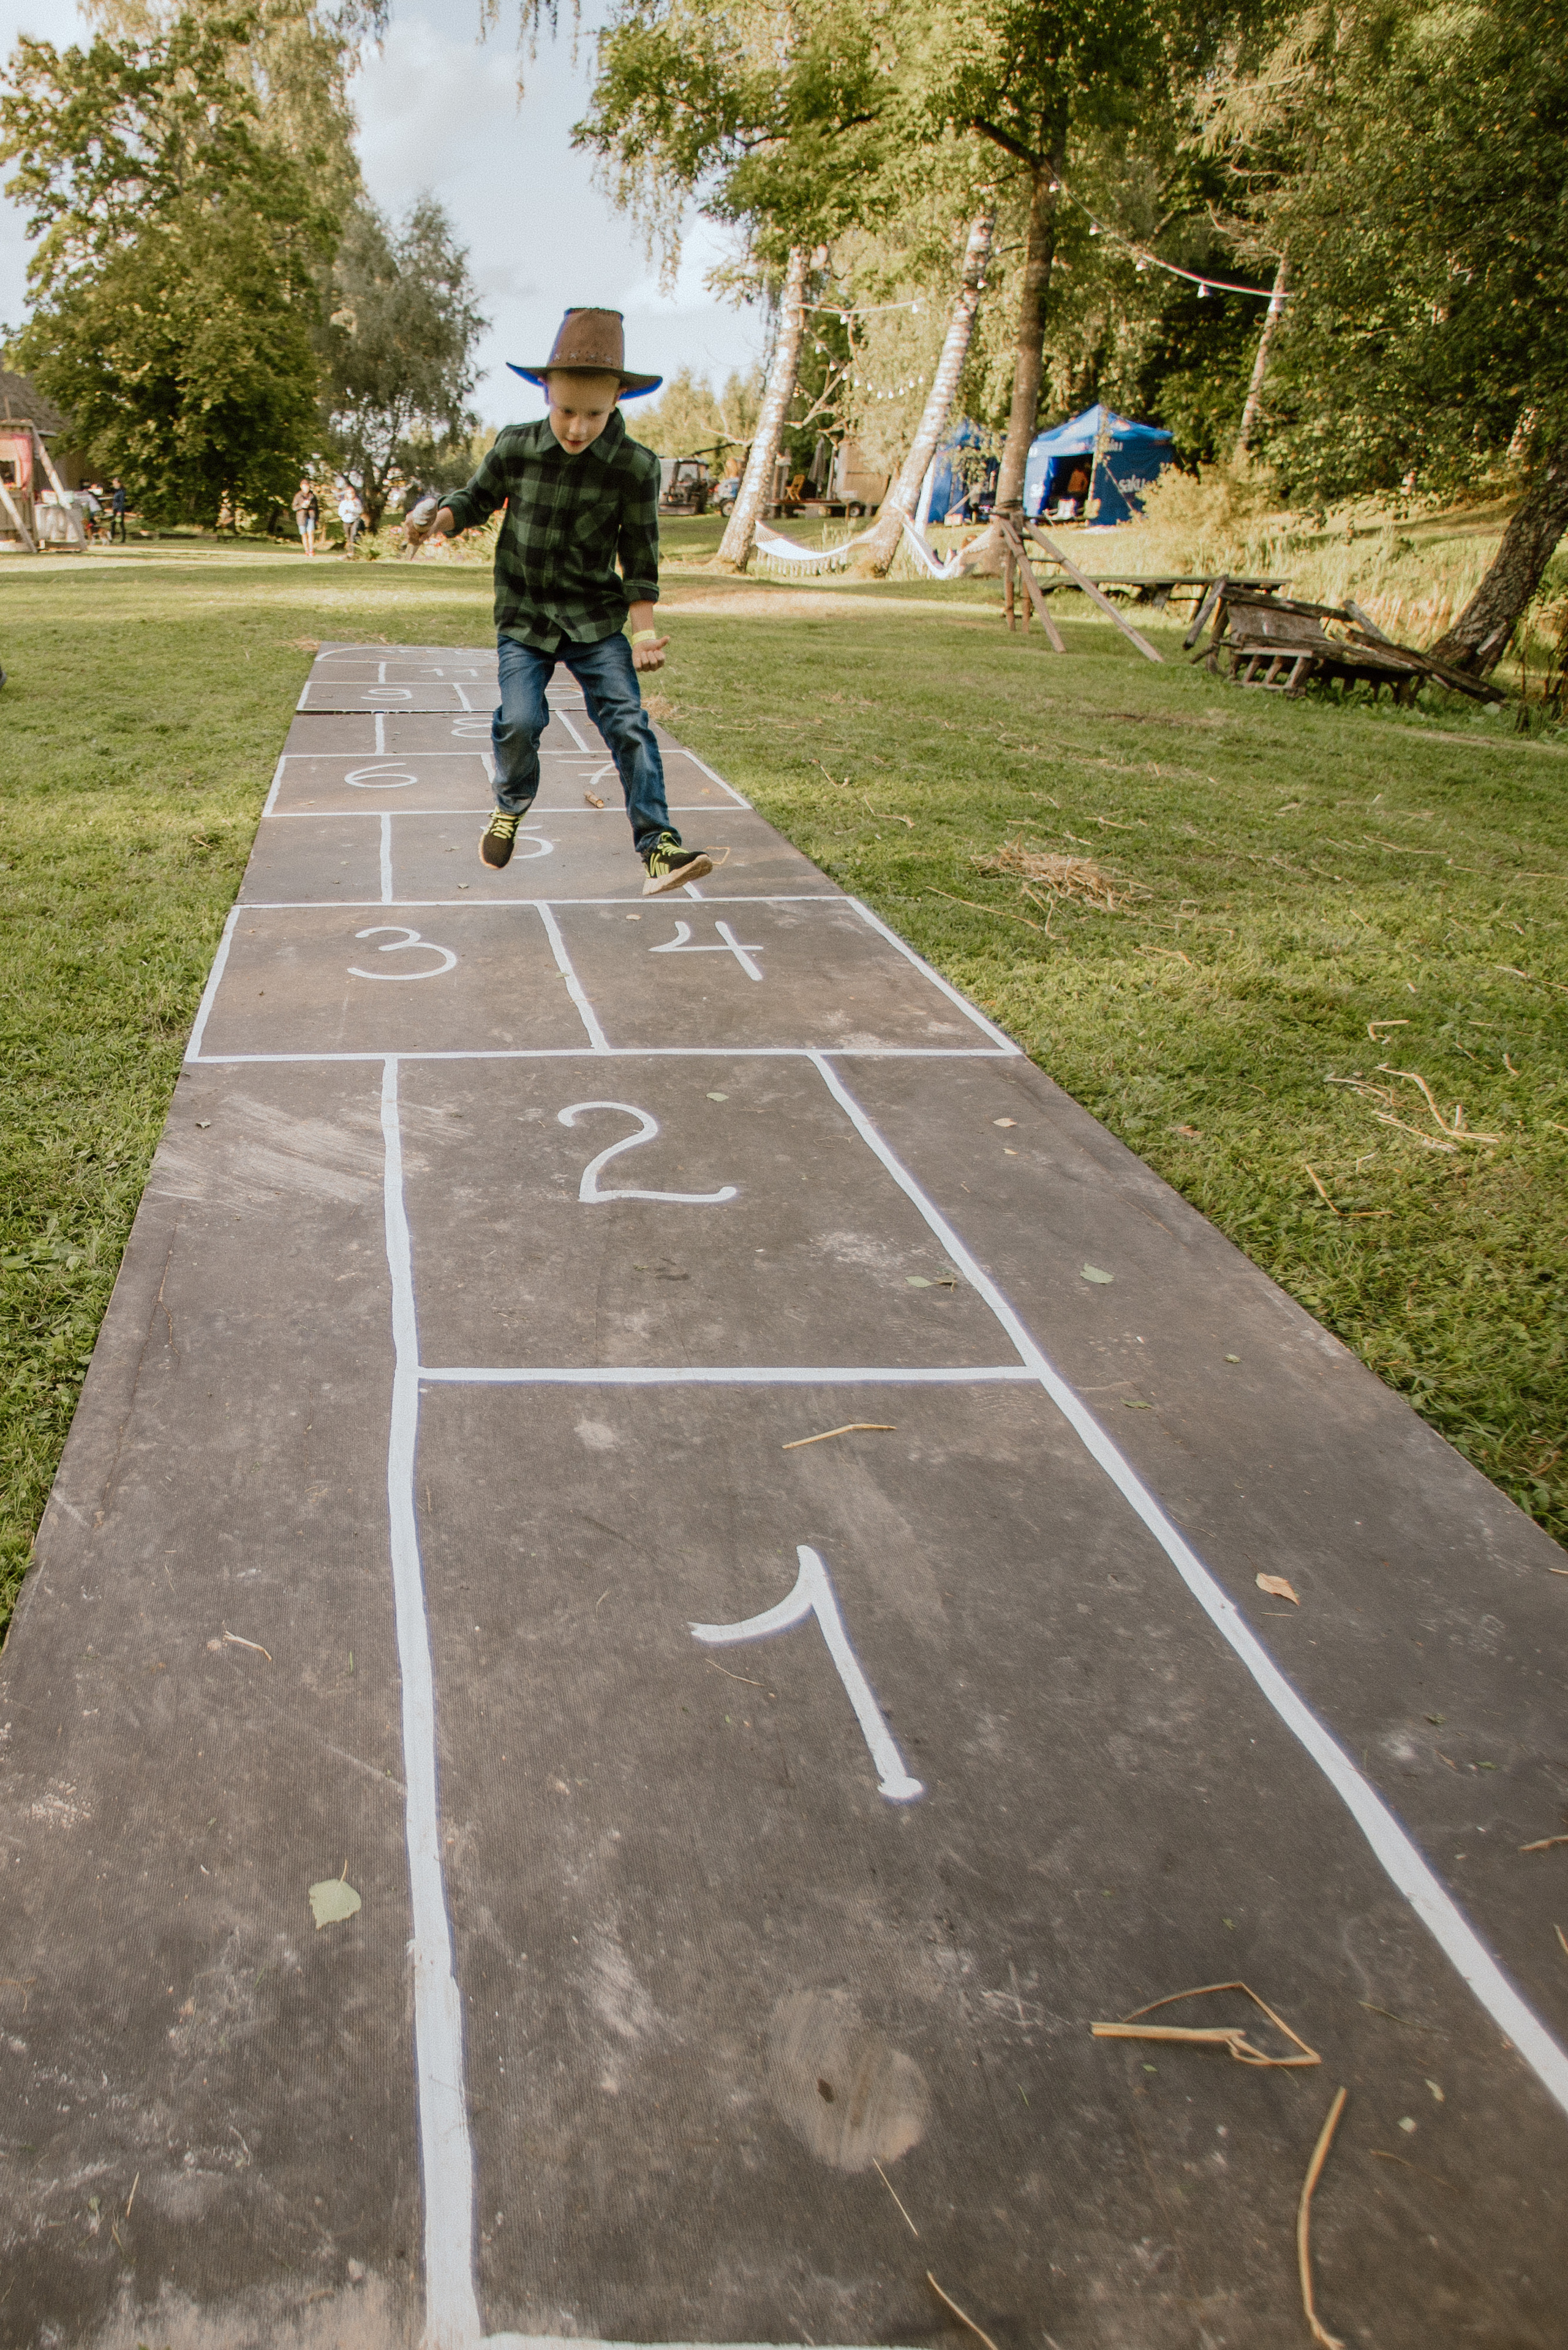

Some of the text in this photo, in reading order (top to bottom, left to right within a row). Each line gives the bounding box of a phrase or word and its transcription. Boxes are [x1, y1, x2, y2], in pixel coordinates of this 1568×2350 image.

[1118, 474, 1146, 493] saku
[360, 689, 412, 701] 9
[344, 763, 418, 788] 6
[347, 926, 457, 981] 3
[649, 920, 764, 981] 4
[558, 1100, 737, 1203] 2
[687, 1544, 923, 1799] 1
